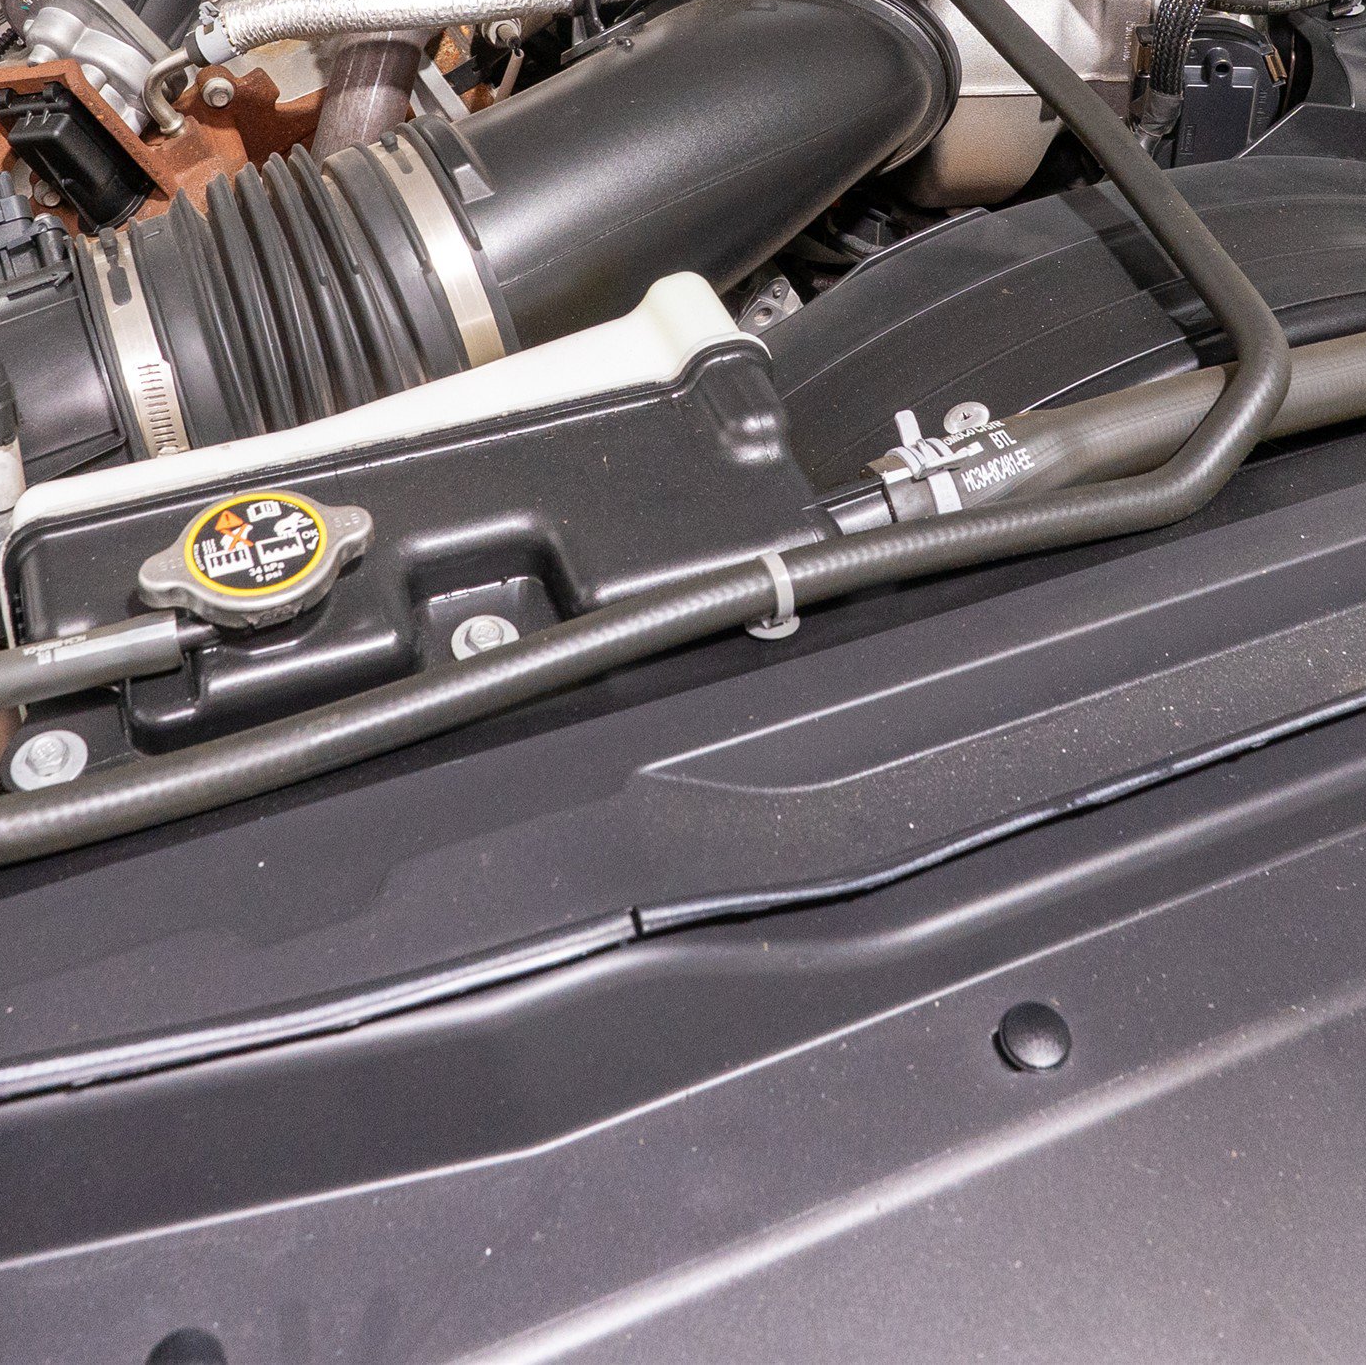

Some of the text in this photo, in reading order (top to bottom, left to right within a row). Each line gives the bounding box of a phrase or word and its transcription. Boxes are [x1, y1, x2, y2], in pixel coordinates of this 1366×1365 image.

[989, 430, 1017, 450] BTL
[301, 530, 320, 540] OK
[249, 562, 285, 577] 34 kPa
[265, 570, 283, 582] psi
